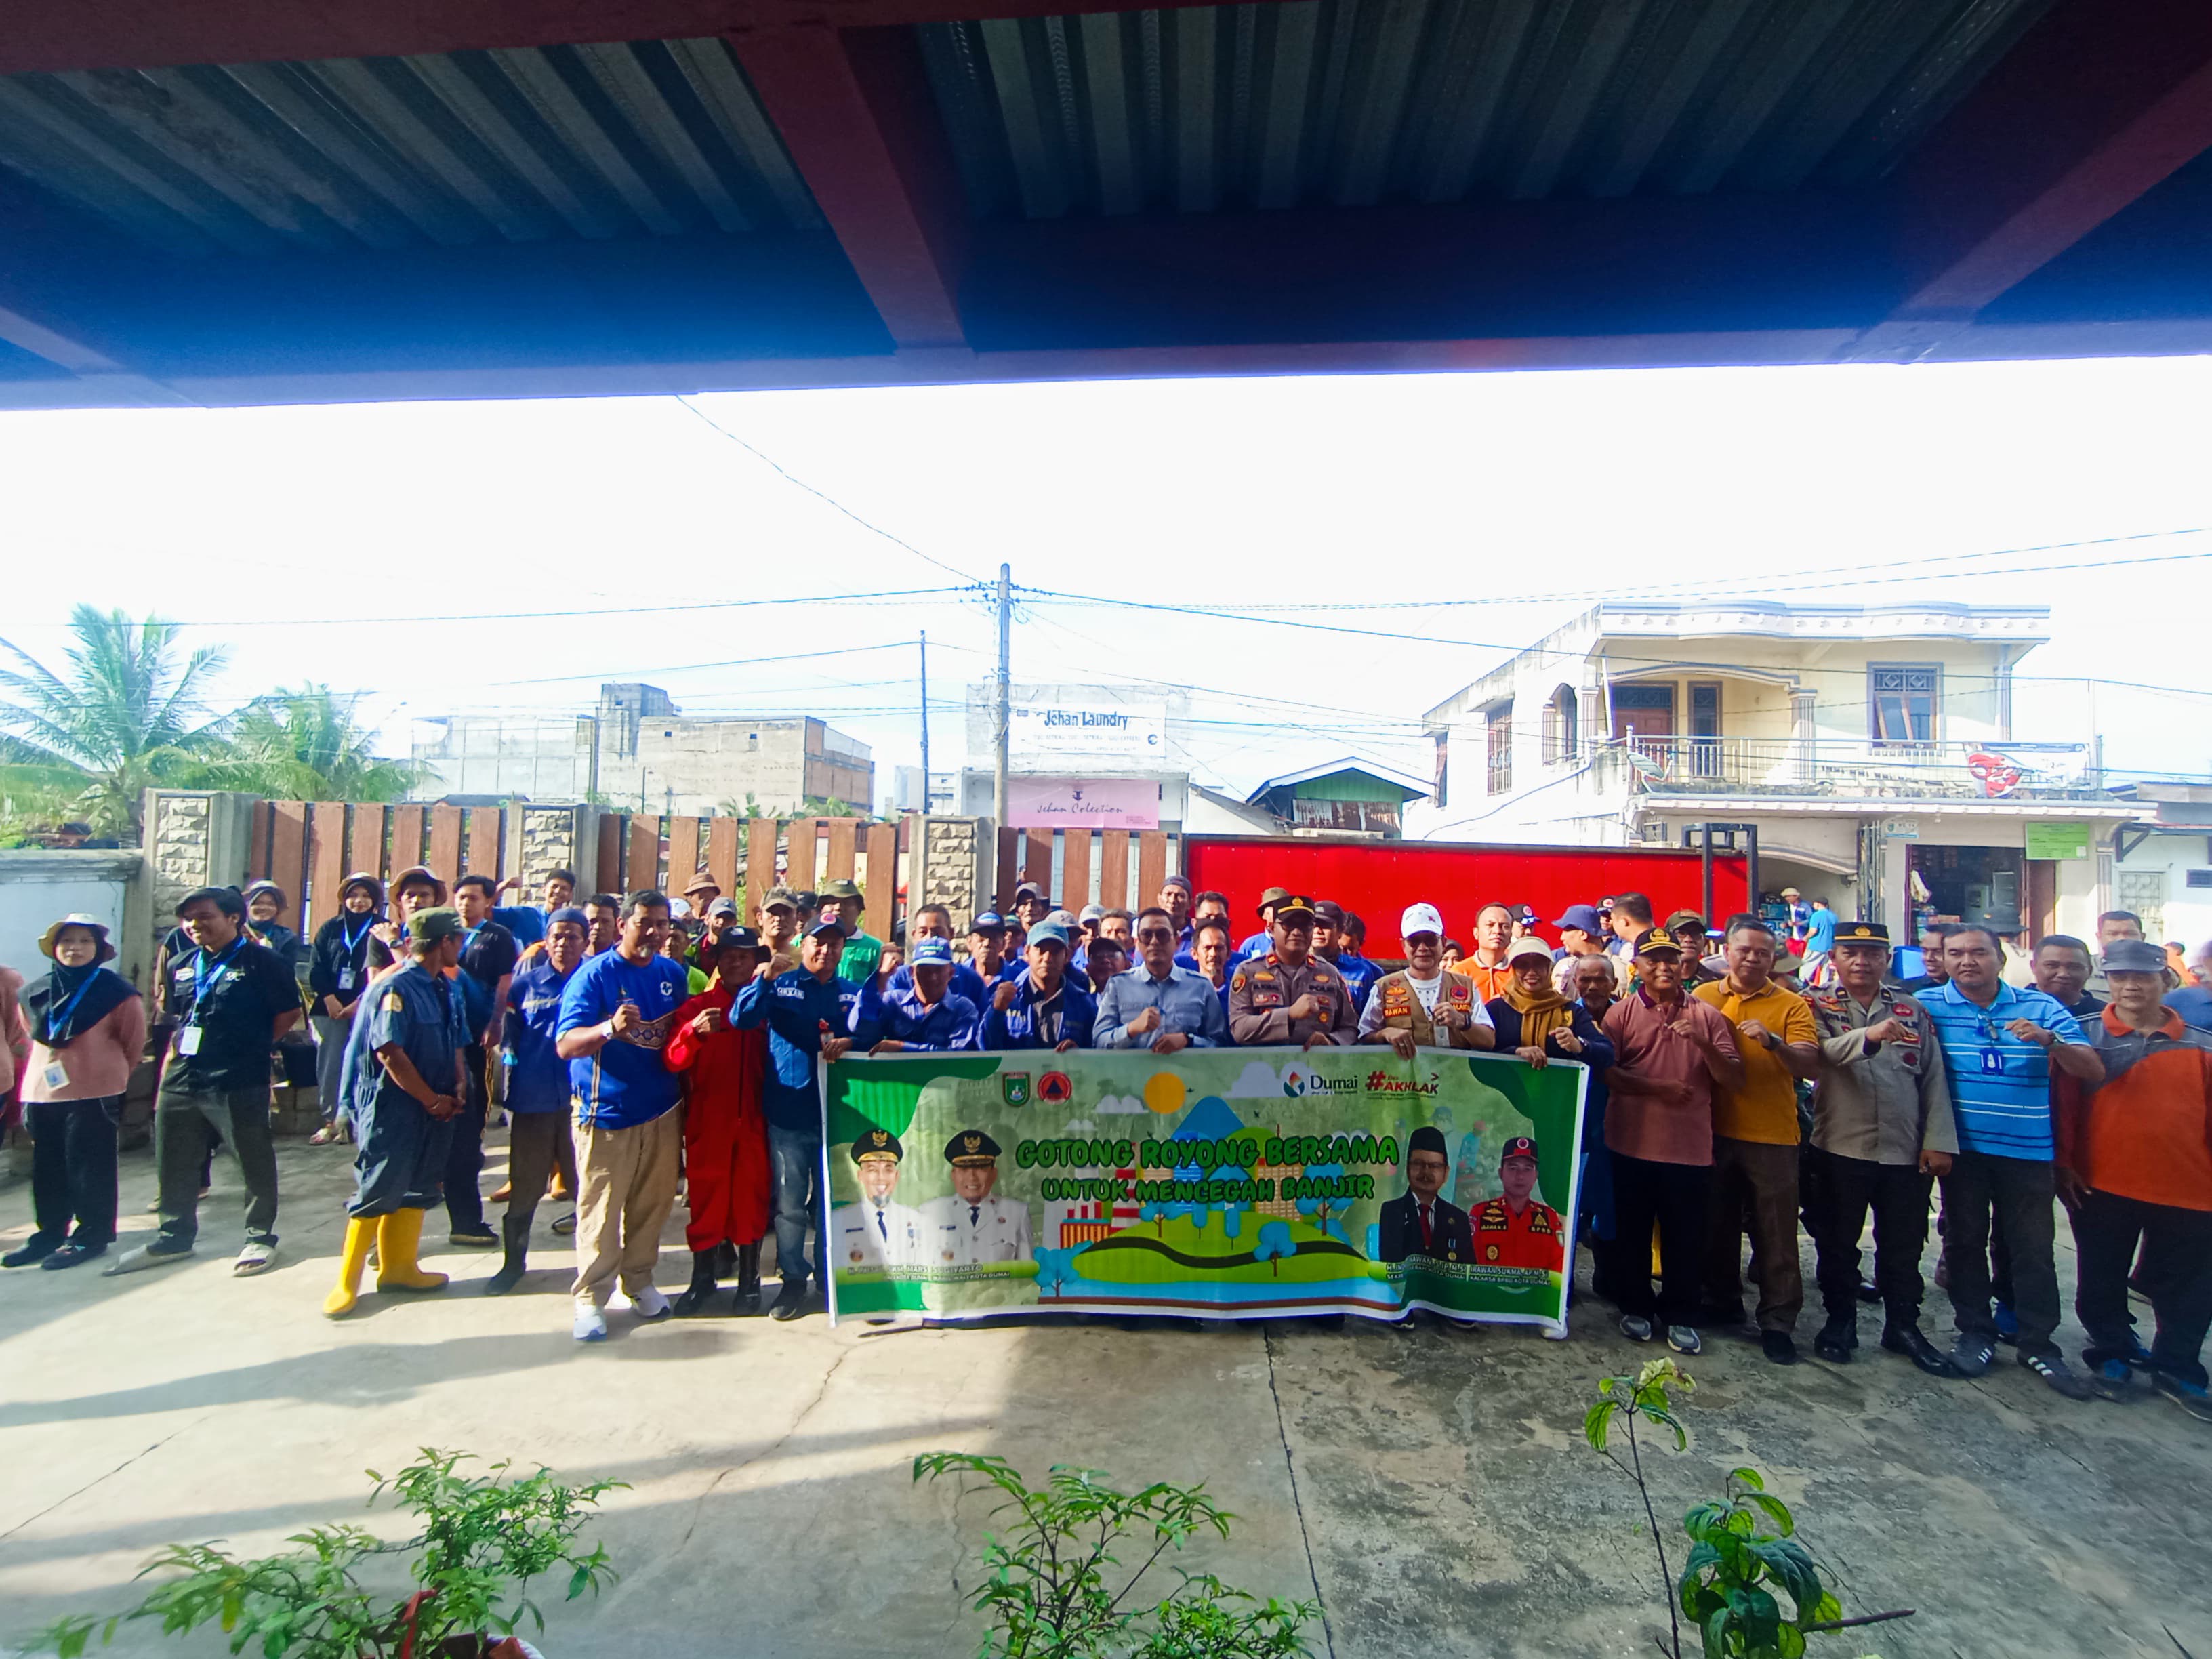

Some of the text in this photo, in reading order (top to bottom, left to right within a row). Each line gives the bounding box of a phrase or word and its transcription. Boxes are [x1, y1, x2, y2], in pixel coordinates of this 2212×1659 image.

[1044, 710, 1128, 731] Jehan Laundry
[1310, 1075, 1358, 1090] Dumai
[1017, 1135, 1400, 1169] GOTONG ROYONG BERSAMA
[1041, 1174, 1375, 1204] UNTUK MENCEGAH BANJIR
